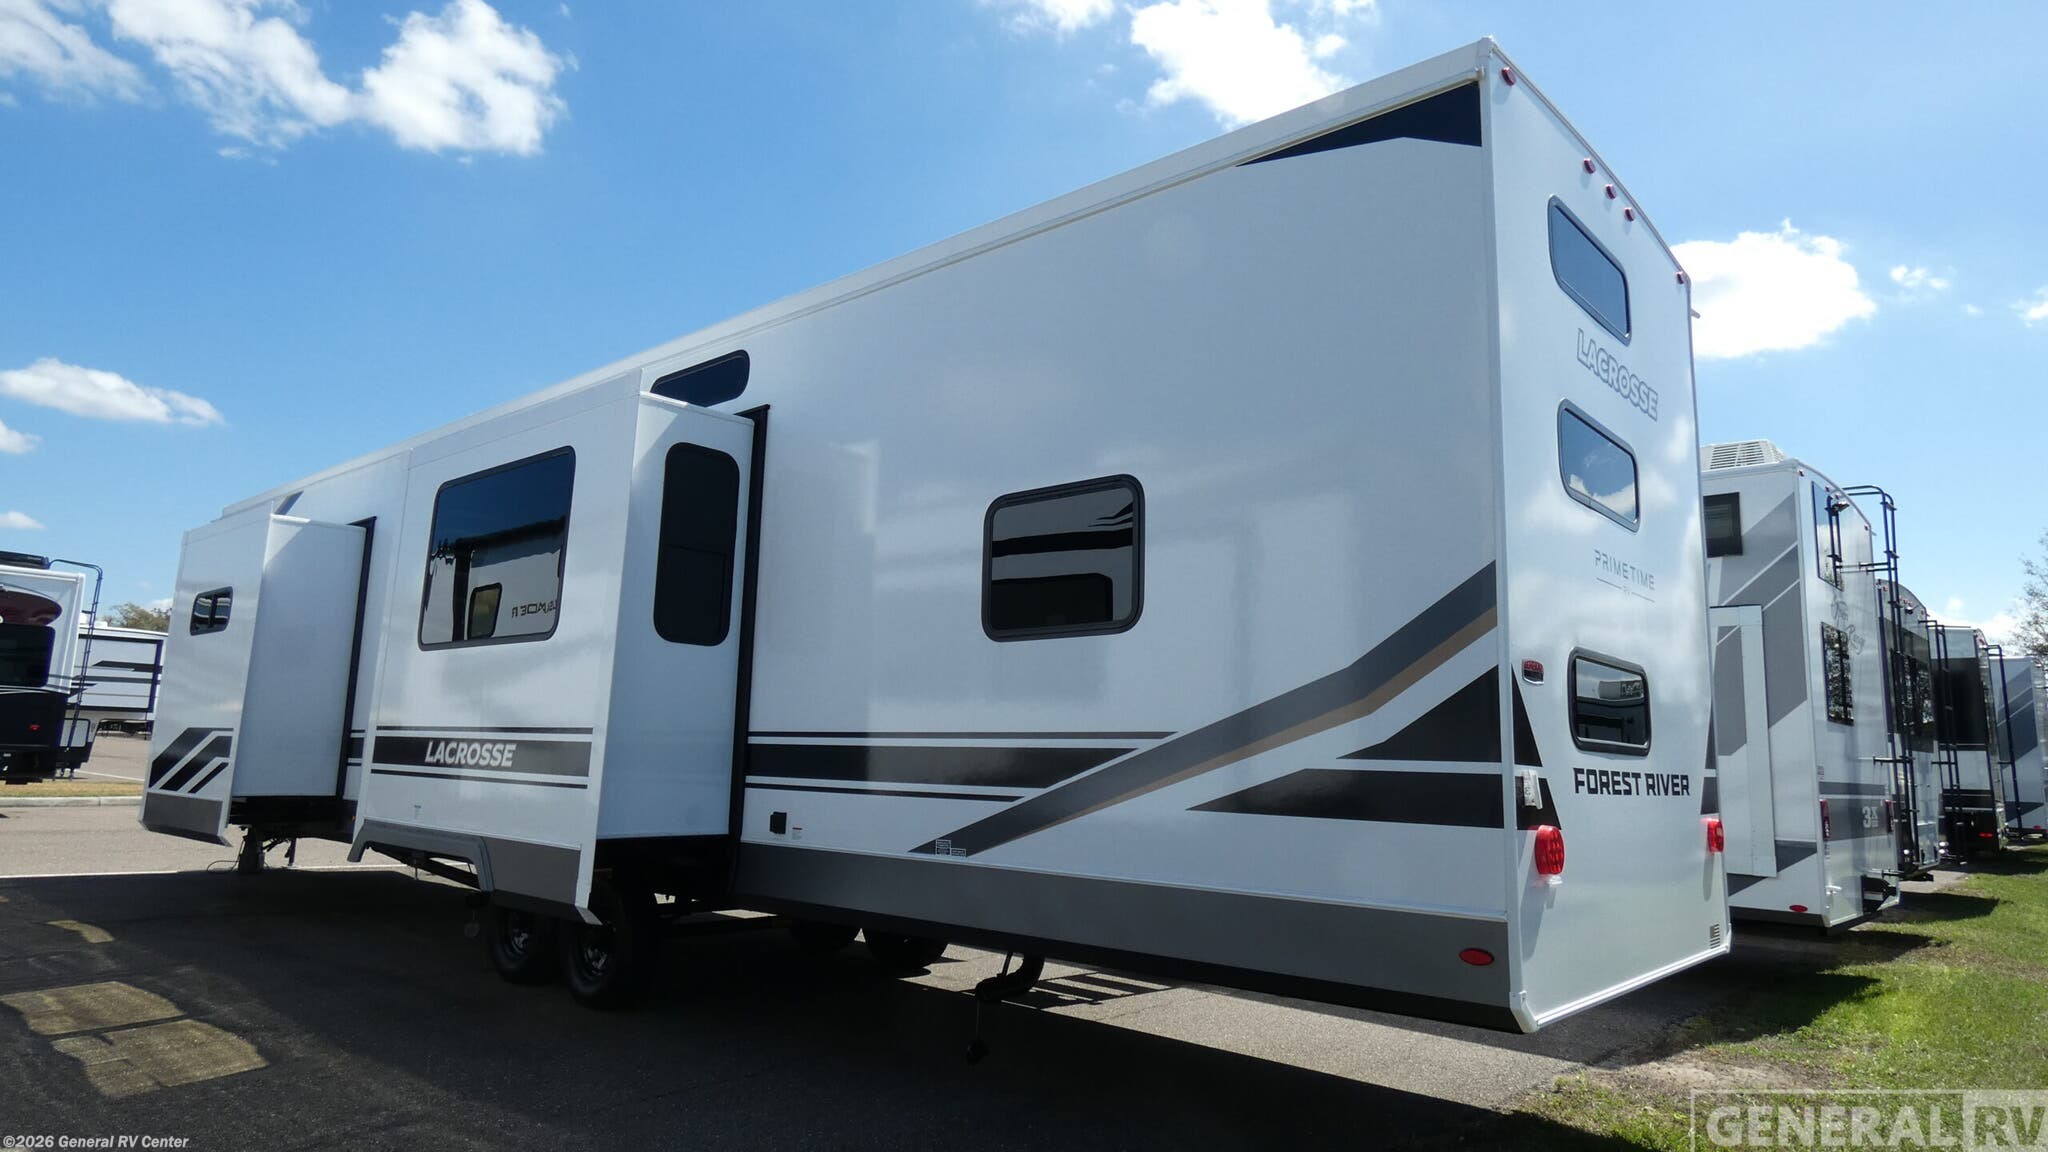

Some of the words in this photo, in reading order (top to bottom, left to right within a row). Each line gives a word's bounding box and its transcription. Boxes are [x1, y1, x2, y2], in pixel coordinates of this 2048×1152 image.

[1577, 328, 1659, 422] LACROSSE
[1594, 549, 1655, 591] PRIMETIME
[424, 740, 516, 768] LACROSSE
[1573, 767, 1642, 796] FOREST
[1646, 773, 1690, 797] RIVER
